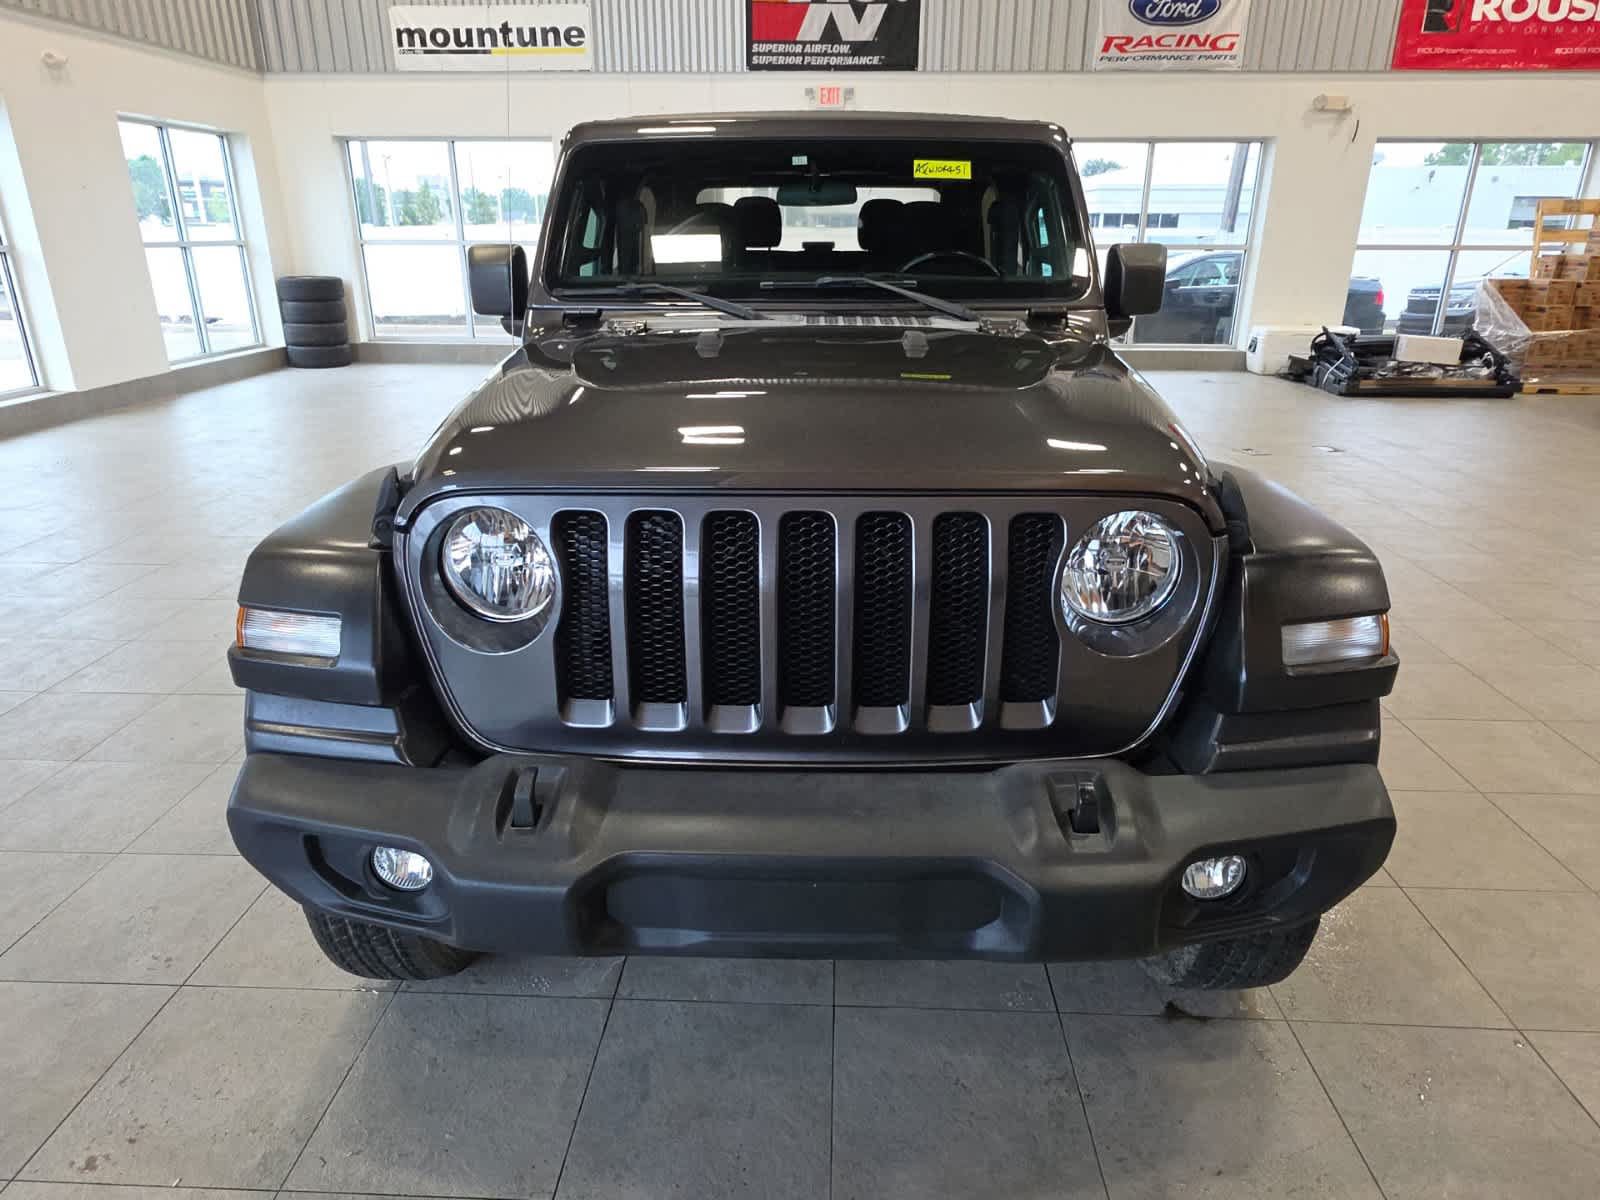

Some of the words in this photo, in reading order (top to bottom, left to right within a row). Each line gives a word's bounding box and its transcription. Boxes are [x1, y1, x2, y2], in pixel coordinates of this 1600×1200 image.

[1145, 0, 1201, 18] Ford
[1471, 0, 1600, 22] ROUS
[396, 21, 586, 48] mountune
[1101, 34, 1240, 53] RACING
[752, 44, 802, 53] SUPERIOR
[803, 44, 851, 53] AIRFLOW.
[752, 56, 802, 65] SUPERIOR
[820, 87, 840, 104] EXIT
